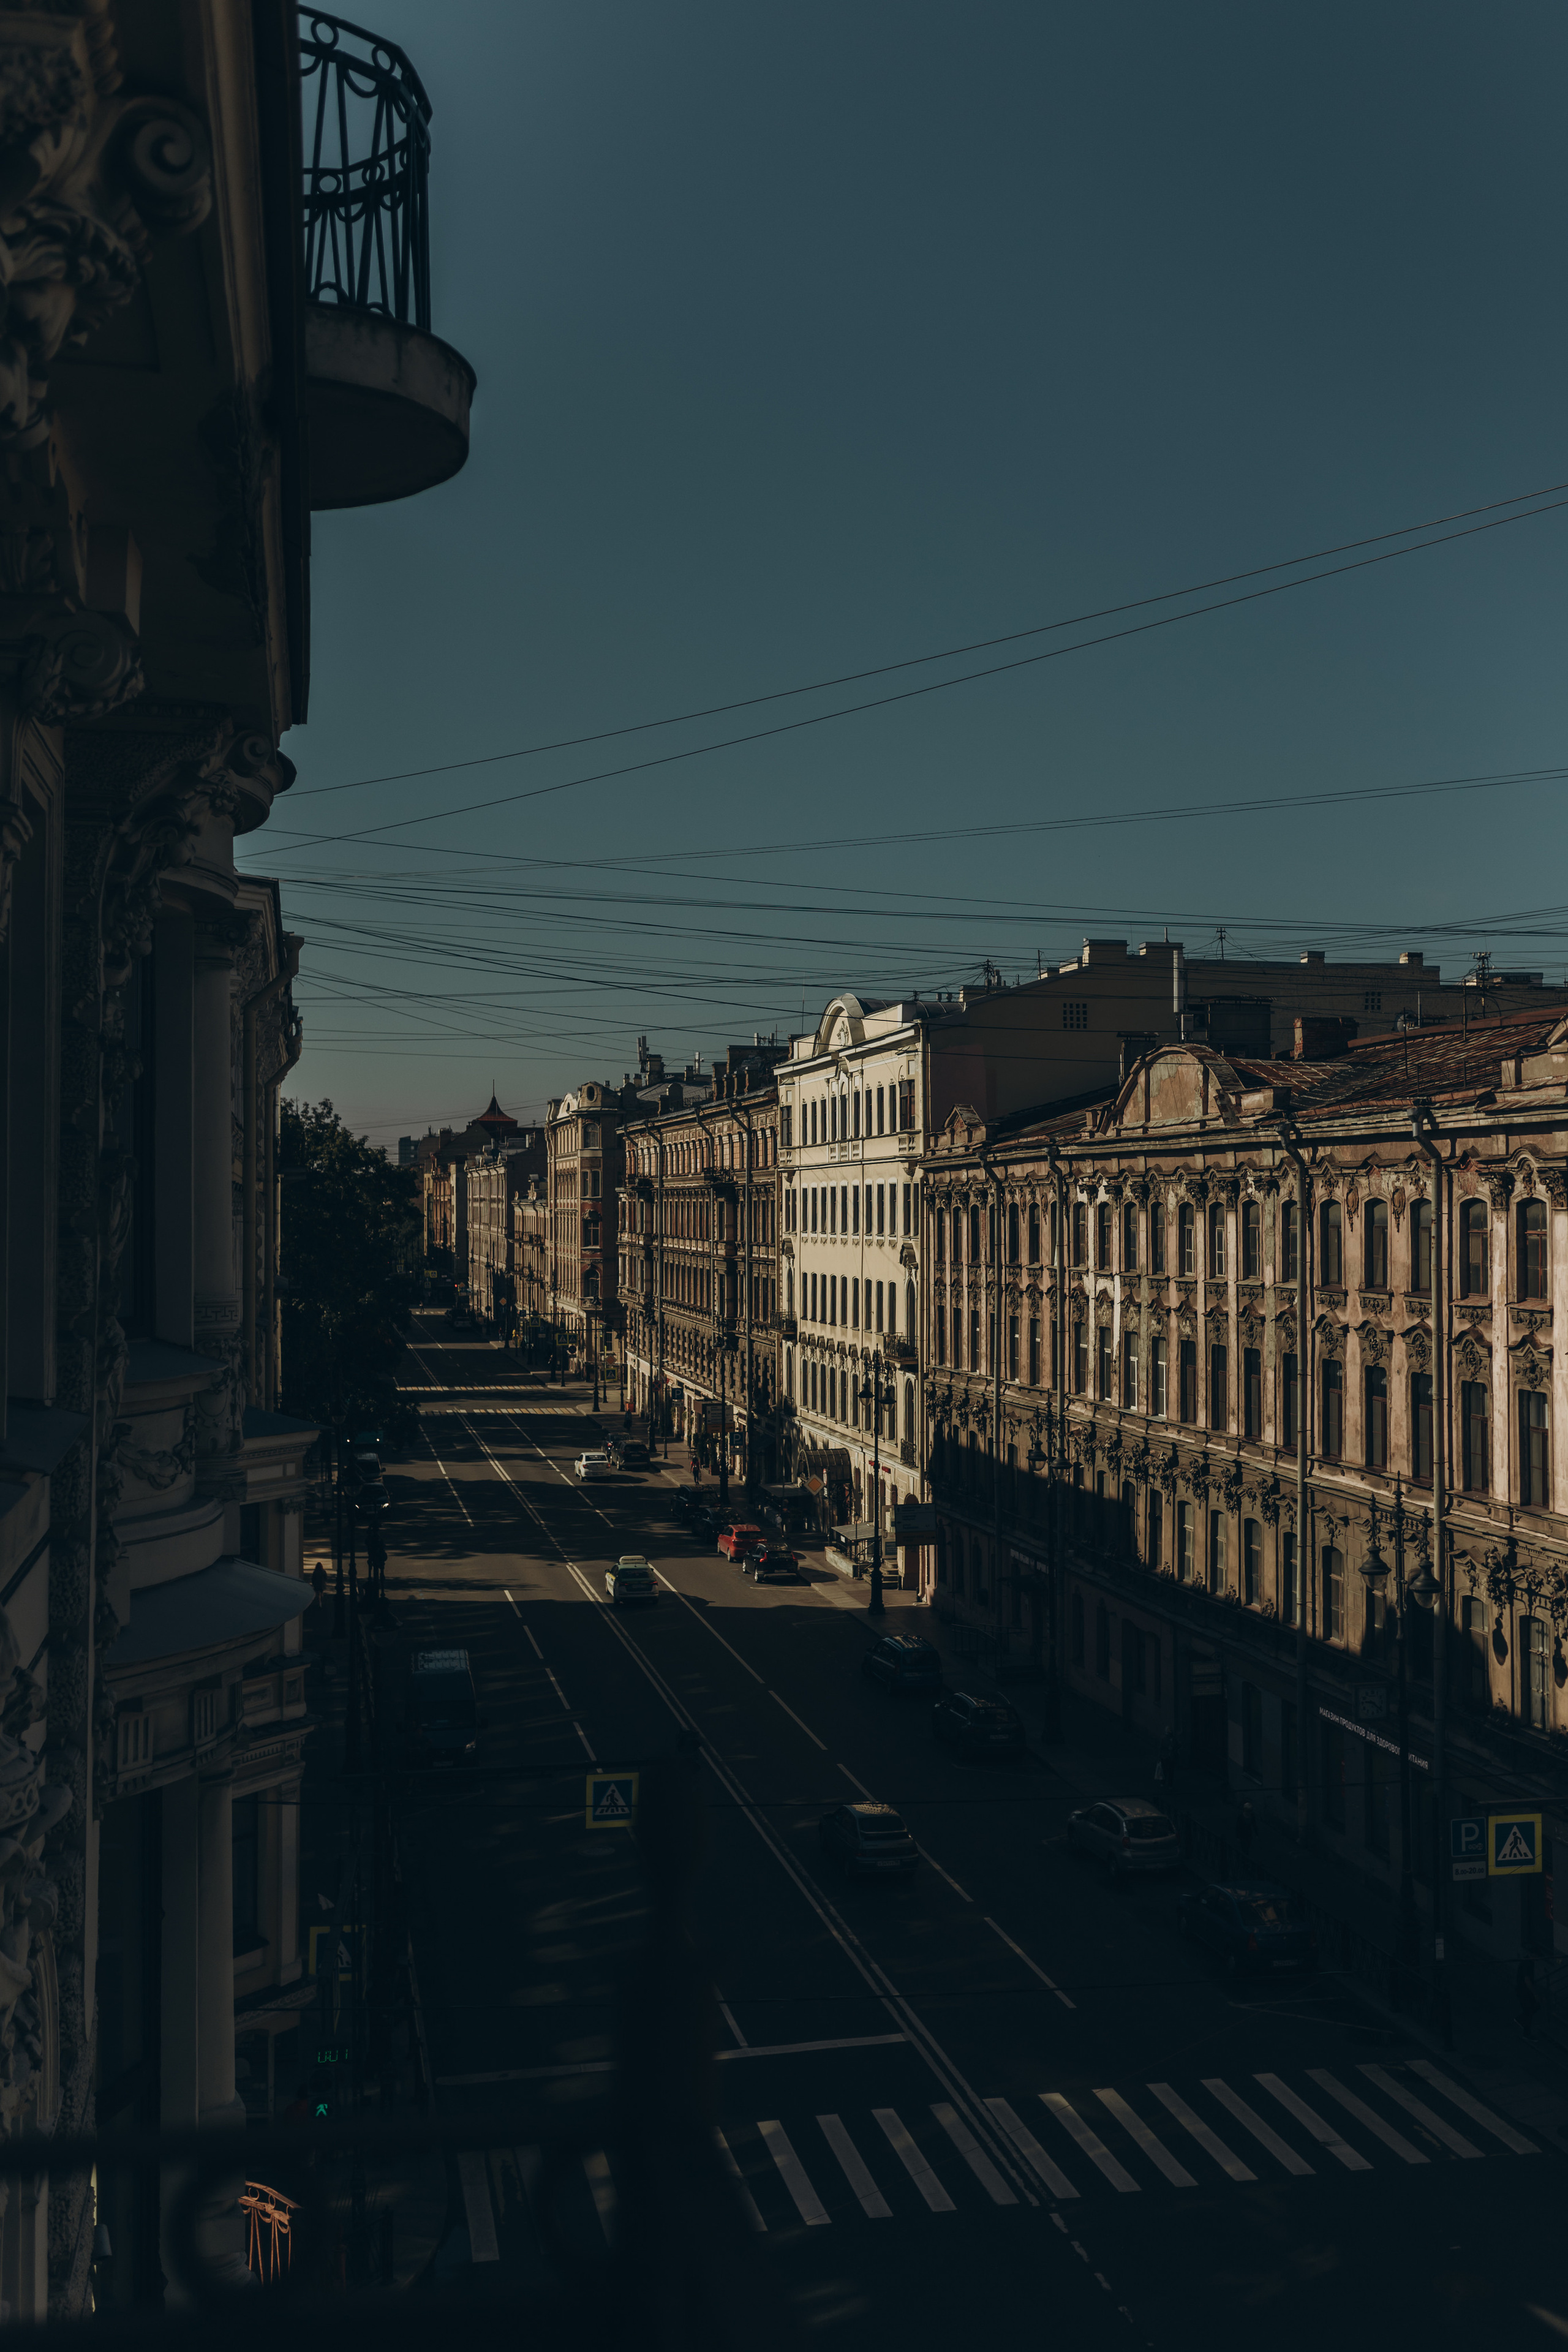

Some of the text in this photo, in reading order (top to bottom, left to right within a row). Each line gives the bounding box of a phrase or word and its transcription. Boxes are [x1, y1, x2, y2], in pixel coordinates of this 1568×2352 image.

[675, 1389, 682, 1398] P
[733, 1433, 741, 1444] P
[1319, 1706, 1428, 1770] МАГАЗИН ПРОДУКТОВ ДЛЯ ЗДОРОВОГ ИТАНИЯ
[1461, 1823, 1479, 1852] P
[1455, 1866, 1485, 1875] 8.00-20.00
